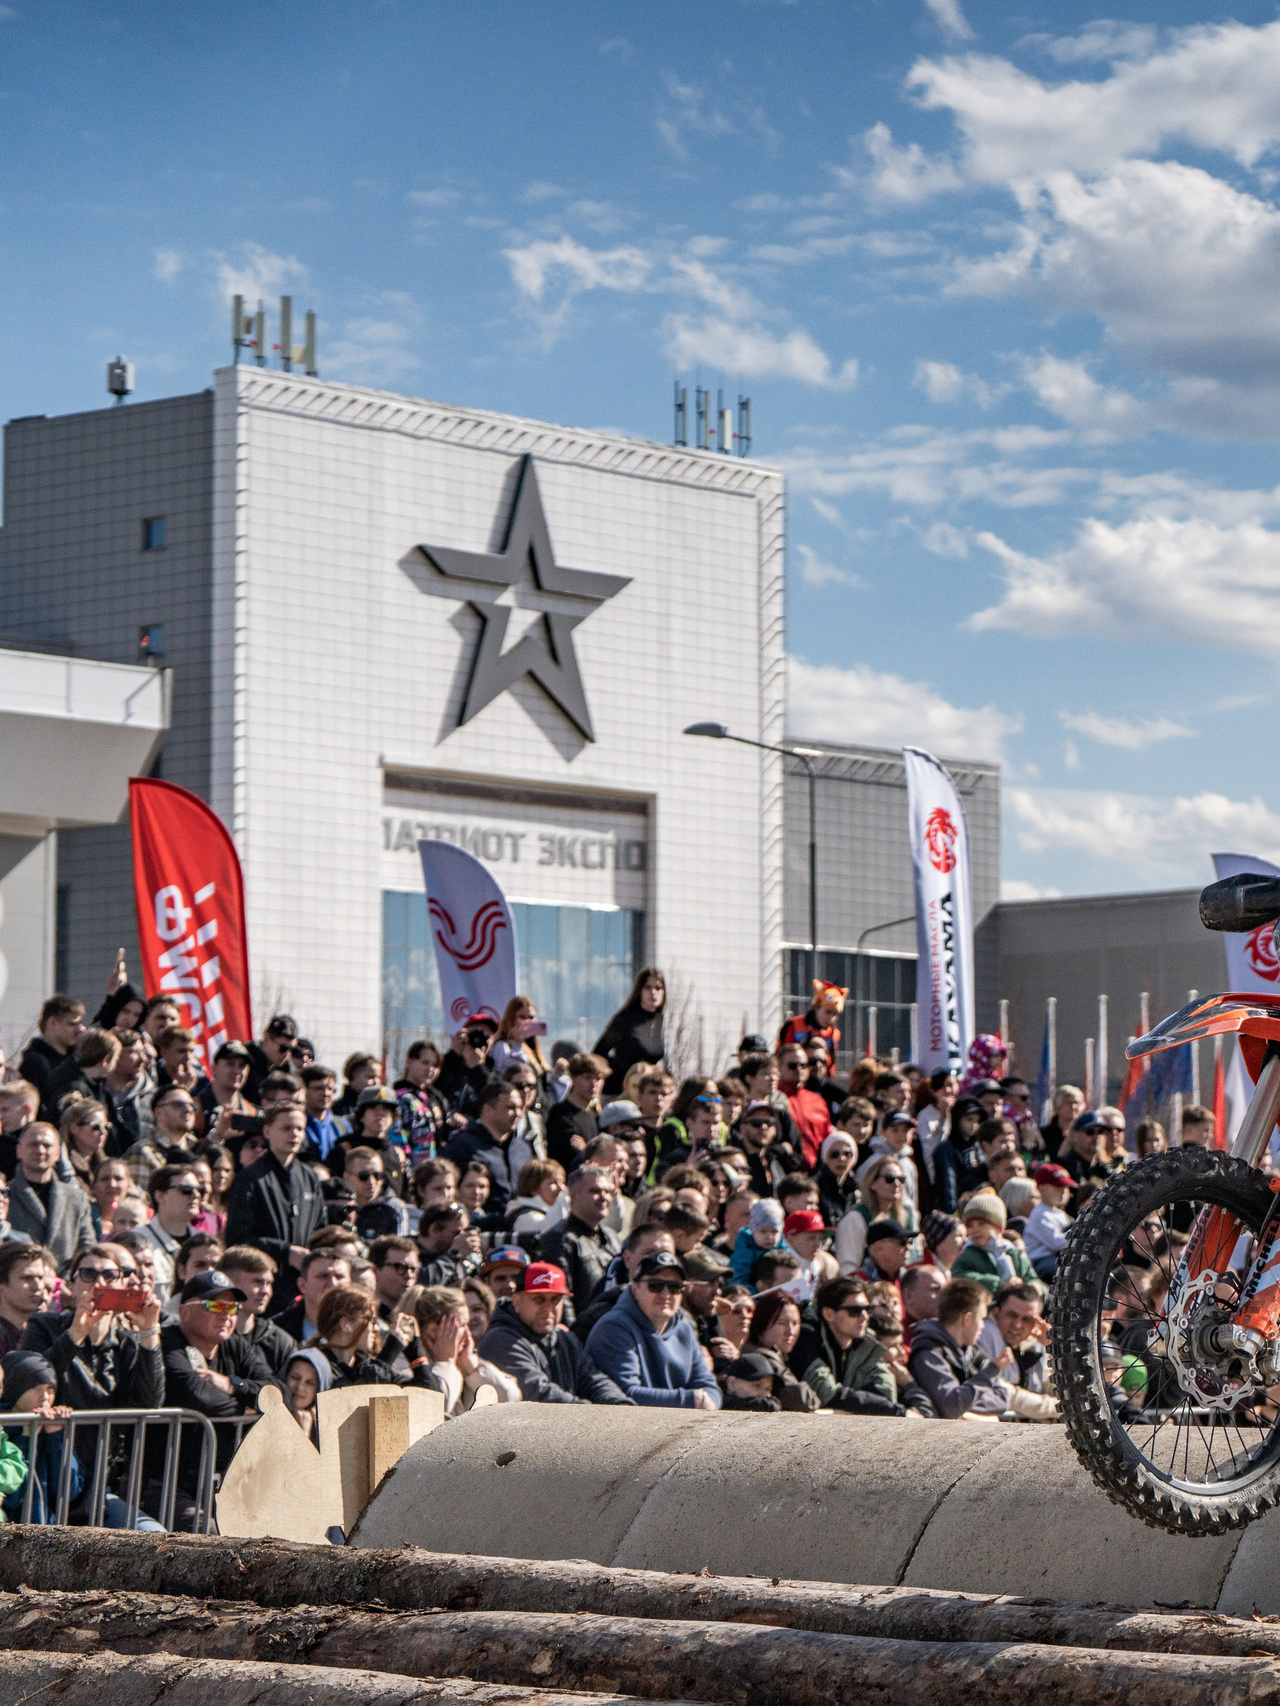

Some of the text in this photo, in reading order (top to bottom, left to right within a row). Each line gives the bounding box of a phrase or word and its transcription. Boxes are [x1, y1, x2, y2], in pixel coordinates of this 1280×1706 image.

[538, 833, 647, 871] ЭКСПО
[928, 899, 943, 1052] МОТОРНЫЕ МАСЛА
